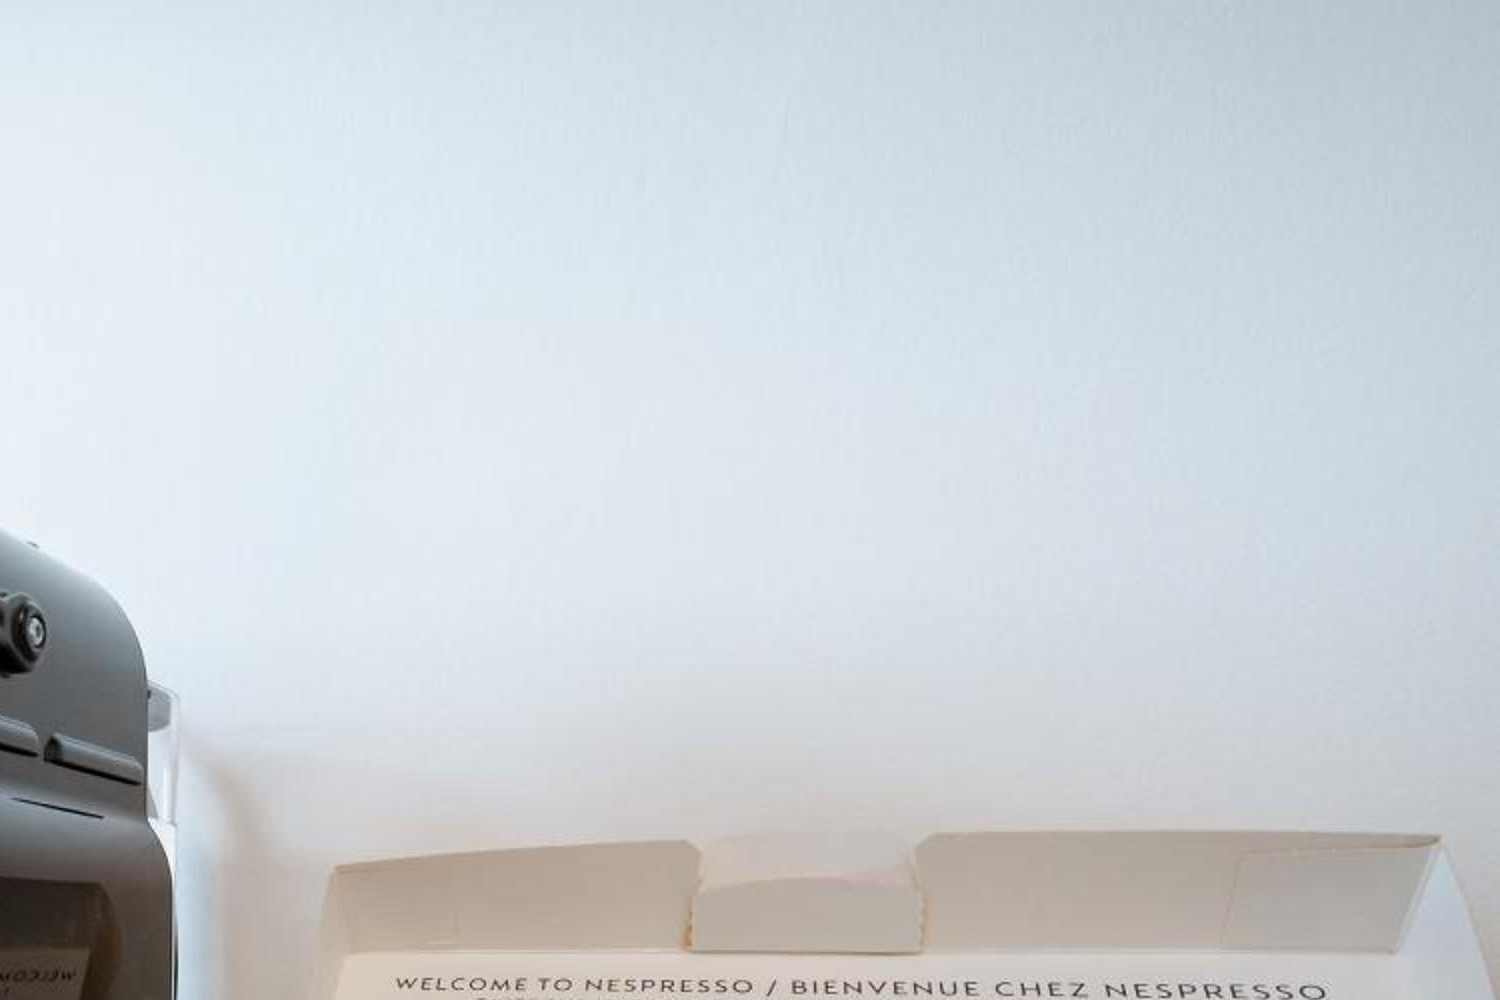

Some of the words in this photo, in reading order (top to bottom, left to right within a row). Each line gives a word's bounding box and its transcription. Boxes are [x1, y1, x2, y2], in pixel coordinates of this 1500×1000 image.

[395, 977, 528, 992] WELCOME
[538, 977, 574, 992] TO
[585, 978, 754, 994] NESPRESSO
[766, 979, 777, 997] /
[791, 980, 981, 997] BIENVENUE
[995, 981, 1089, 998] CHEZ
[1105, 983, 1327, 1000] NESPRESSO
